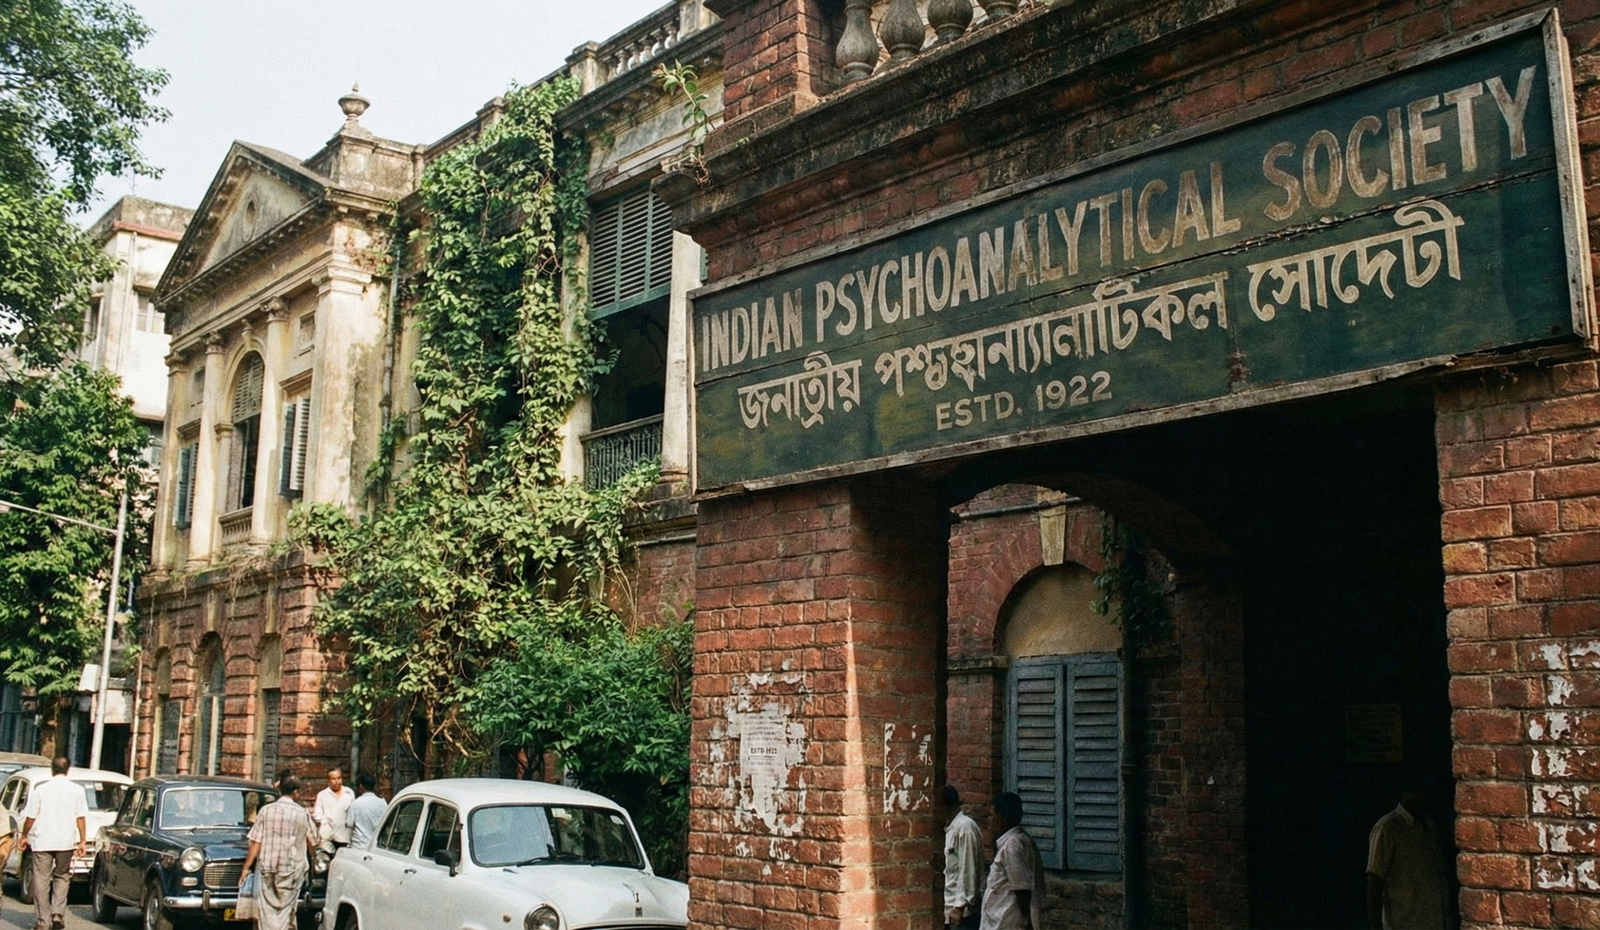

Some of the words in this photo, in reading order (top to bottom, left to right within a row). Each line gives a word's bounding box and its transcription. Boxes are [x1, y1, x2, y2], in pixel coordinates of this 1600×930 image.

[702, 288, 803, 372] INDIAN
[815, 162, 1241, 343] PSYCHOANALYTICAL
[1262, 65, 1537, 221] SOCIETY
[935, 391, 1023, 431] ESTD.
[1035, 370, 1113, 412] 1922
